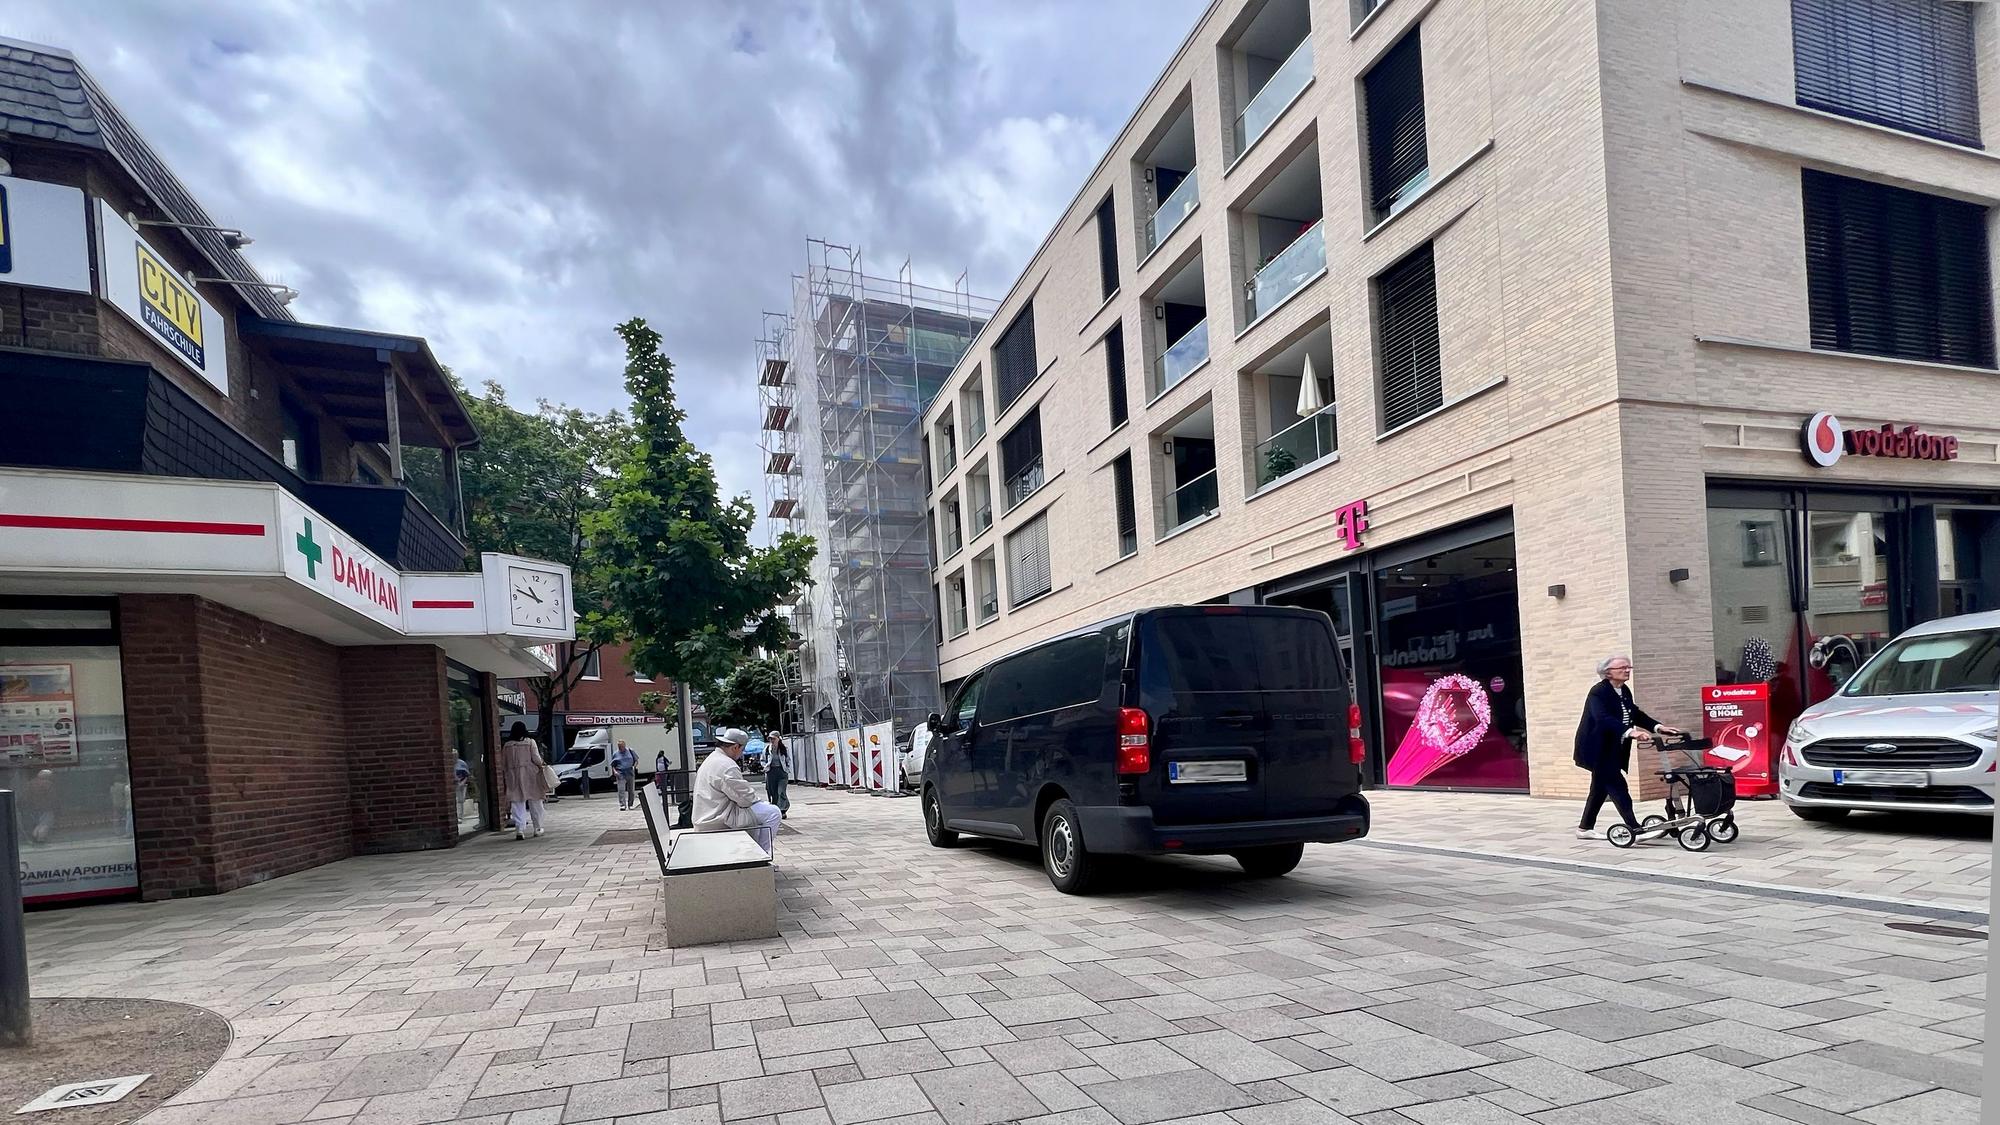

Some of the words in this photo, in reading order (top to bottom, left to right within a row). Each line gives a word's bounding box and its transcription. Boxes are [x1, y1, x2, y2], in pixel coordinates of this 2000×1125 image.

[142, 257, 196, 335] CITY
[145, 305, 201, 364] FAHRSCHULE
[1842, 423, 1959, 461] vodafone
[332, 545, 399, 615] DAMIAN
